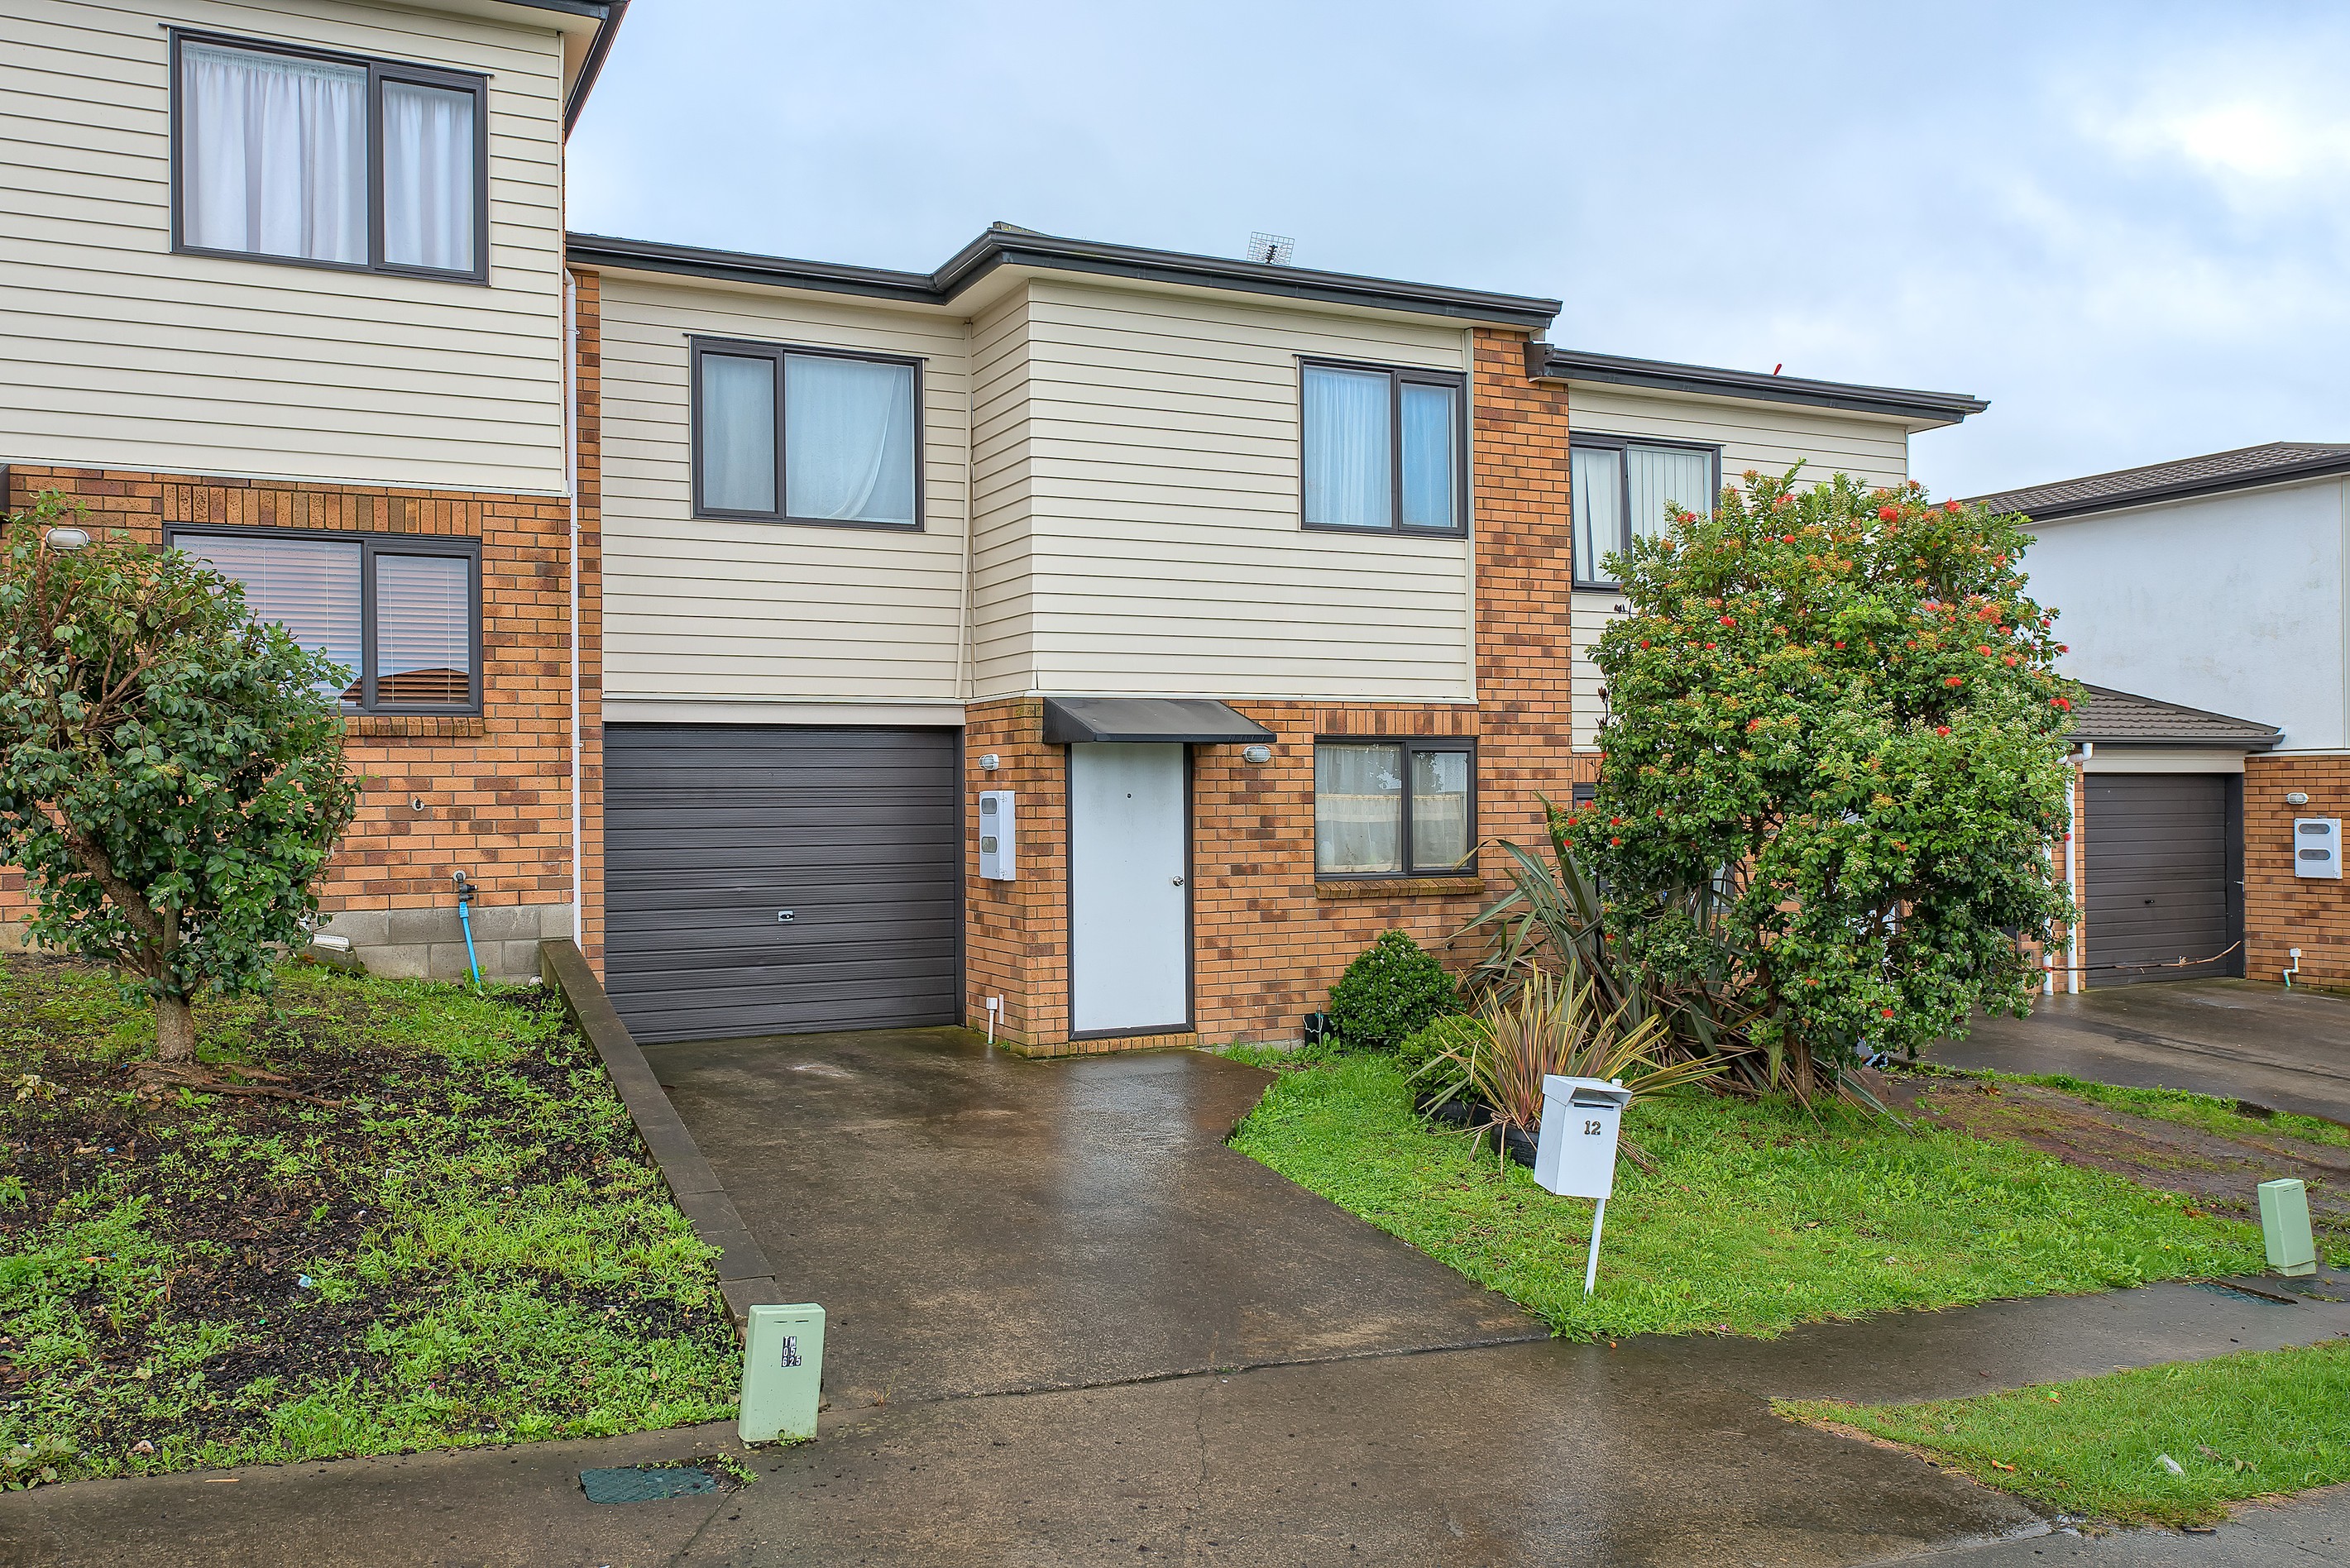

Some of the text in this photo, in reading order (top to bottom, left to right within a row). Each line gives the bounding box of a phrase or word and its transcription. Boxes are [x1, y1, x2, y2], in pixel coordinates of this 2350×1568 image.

[1584, 1120, 1601, 1135] 12
[783, 1336, 797, 1346] TM
[783, 1346, 796, 1356] 05
[782, 1356, 802, 1366] 625
